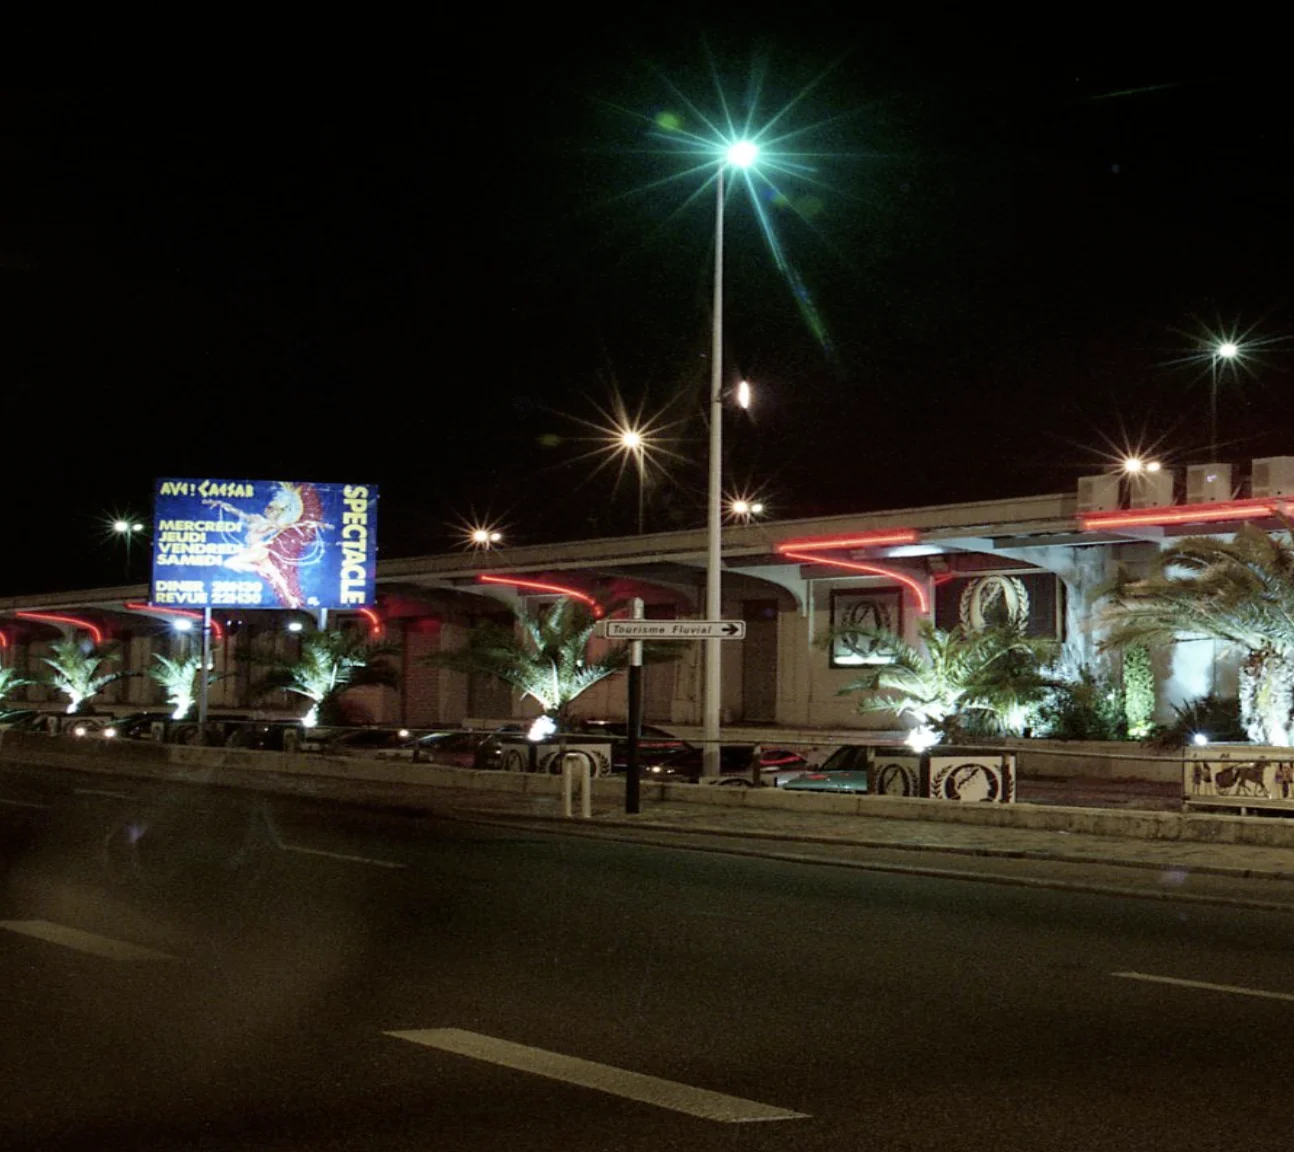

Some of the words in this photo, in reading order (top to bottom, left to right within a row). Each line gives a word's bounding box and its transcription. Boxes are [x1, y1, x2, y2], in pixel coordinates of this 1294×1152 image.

[159, 520, 242, 532] MERCREDI
[159, 532, 206, 543] JEUDI
[339, 484, 369, 604] SPECTACLE
[157, 554, 223, 566] SAMEDI
[155, 592, 208, 603] REVUE
[613, 624, 665, 634] Tourisme
[671, 624, 713, 634] Fluvial
